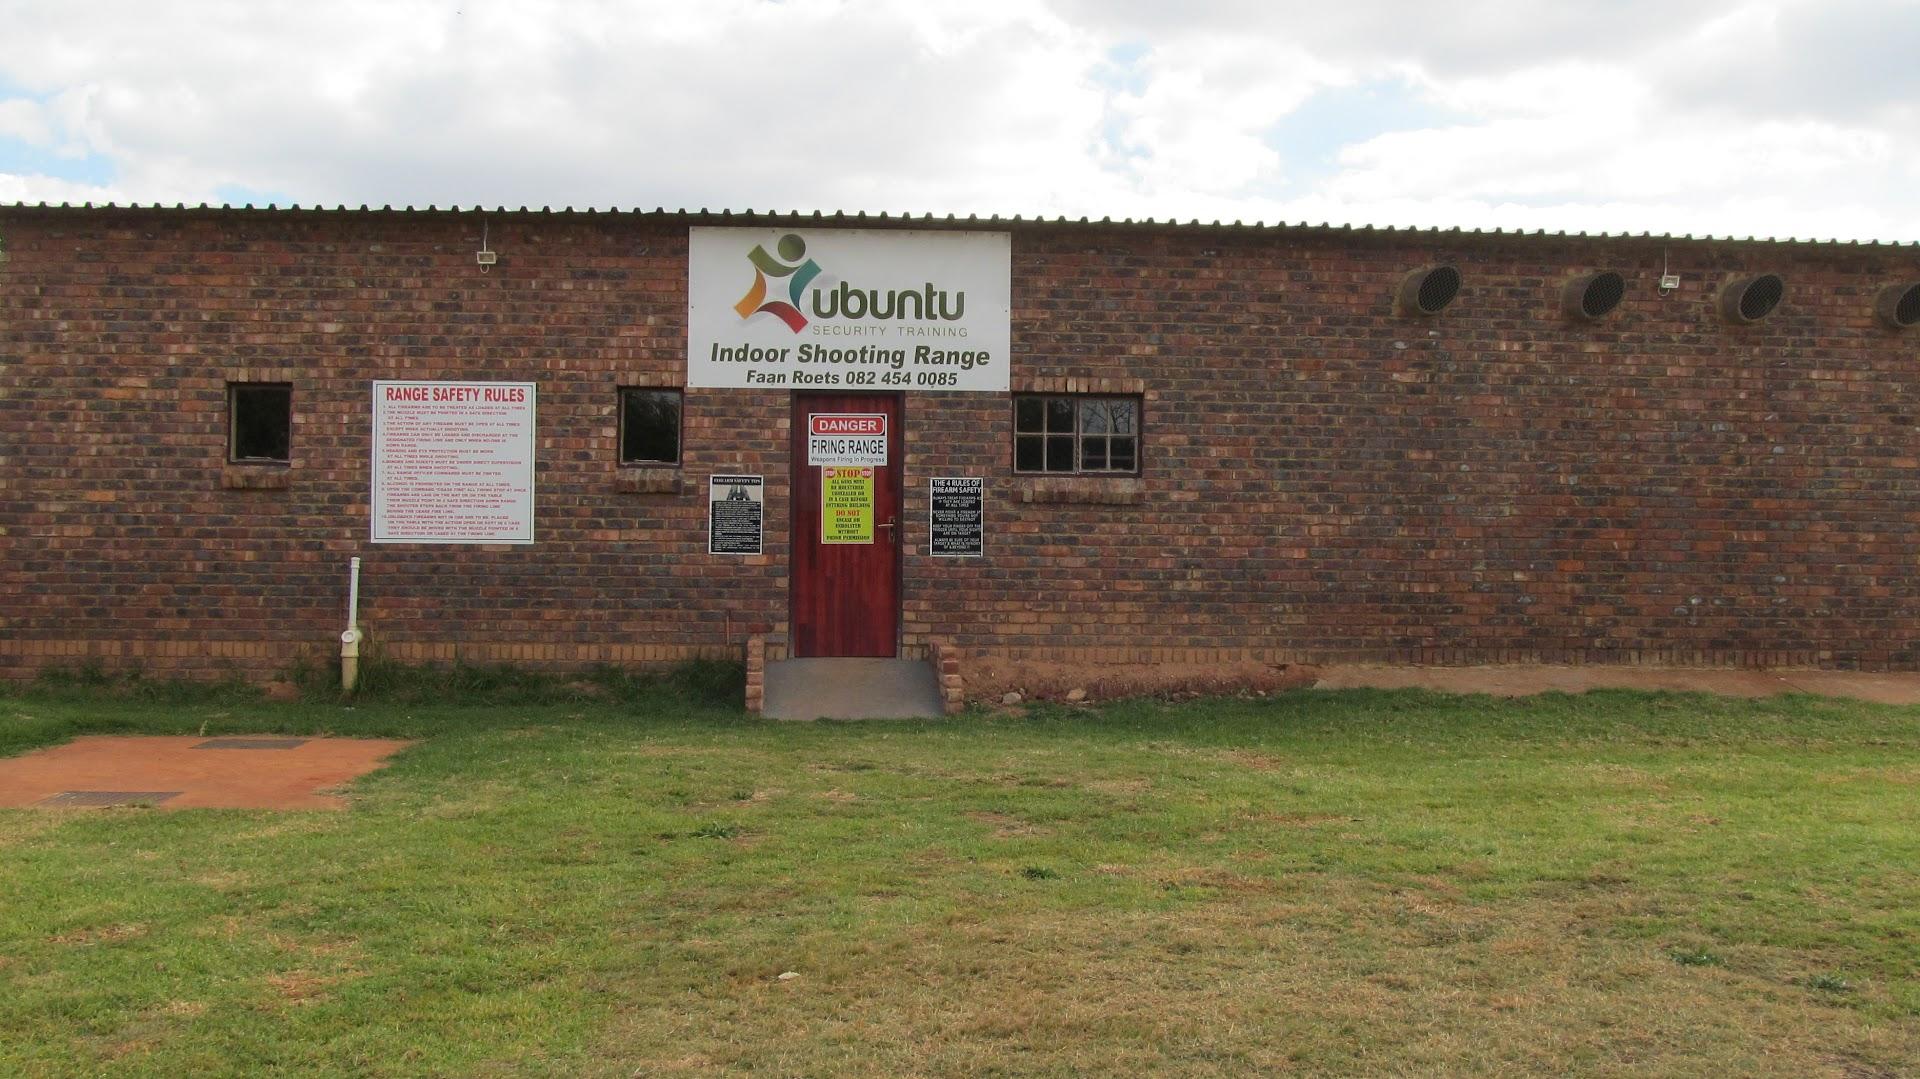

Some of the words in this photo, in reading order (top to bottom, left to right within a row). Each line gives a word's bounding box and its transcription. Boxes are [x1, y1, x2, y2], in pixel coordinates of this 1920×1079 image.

[812, 281, 965, 321] ubuntu
[812, 325, 887, 336] SECURITY
[898, 326, 968, 337] TRAINING
[711, 342, 790, 363] Indoor
[797, 344, 906, 369] Shooting
[914, 346, 990, 370] Range
[746, 370, 786, 384] Faan
[792, 371, 840, 384] Roets
[845, 371, 876, 384] 082
[881, 372, 911, 385] 454
[917, 372, 958, 386] 0085
[386, 387, 429, 401] RANGE
[432, 388, 480, 401] SAFETY
[484, 388, 525, 402] RULES
[819, 420, 877, 431] DANGER
[811, 440, 845, 454] FIRING
[848, 440, 884, 454] RANGE
[837, 470, 860, 478] STOP
